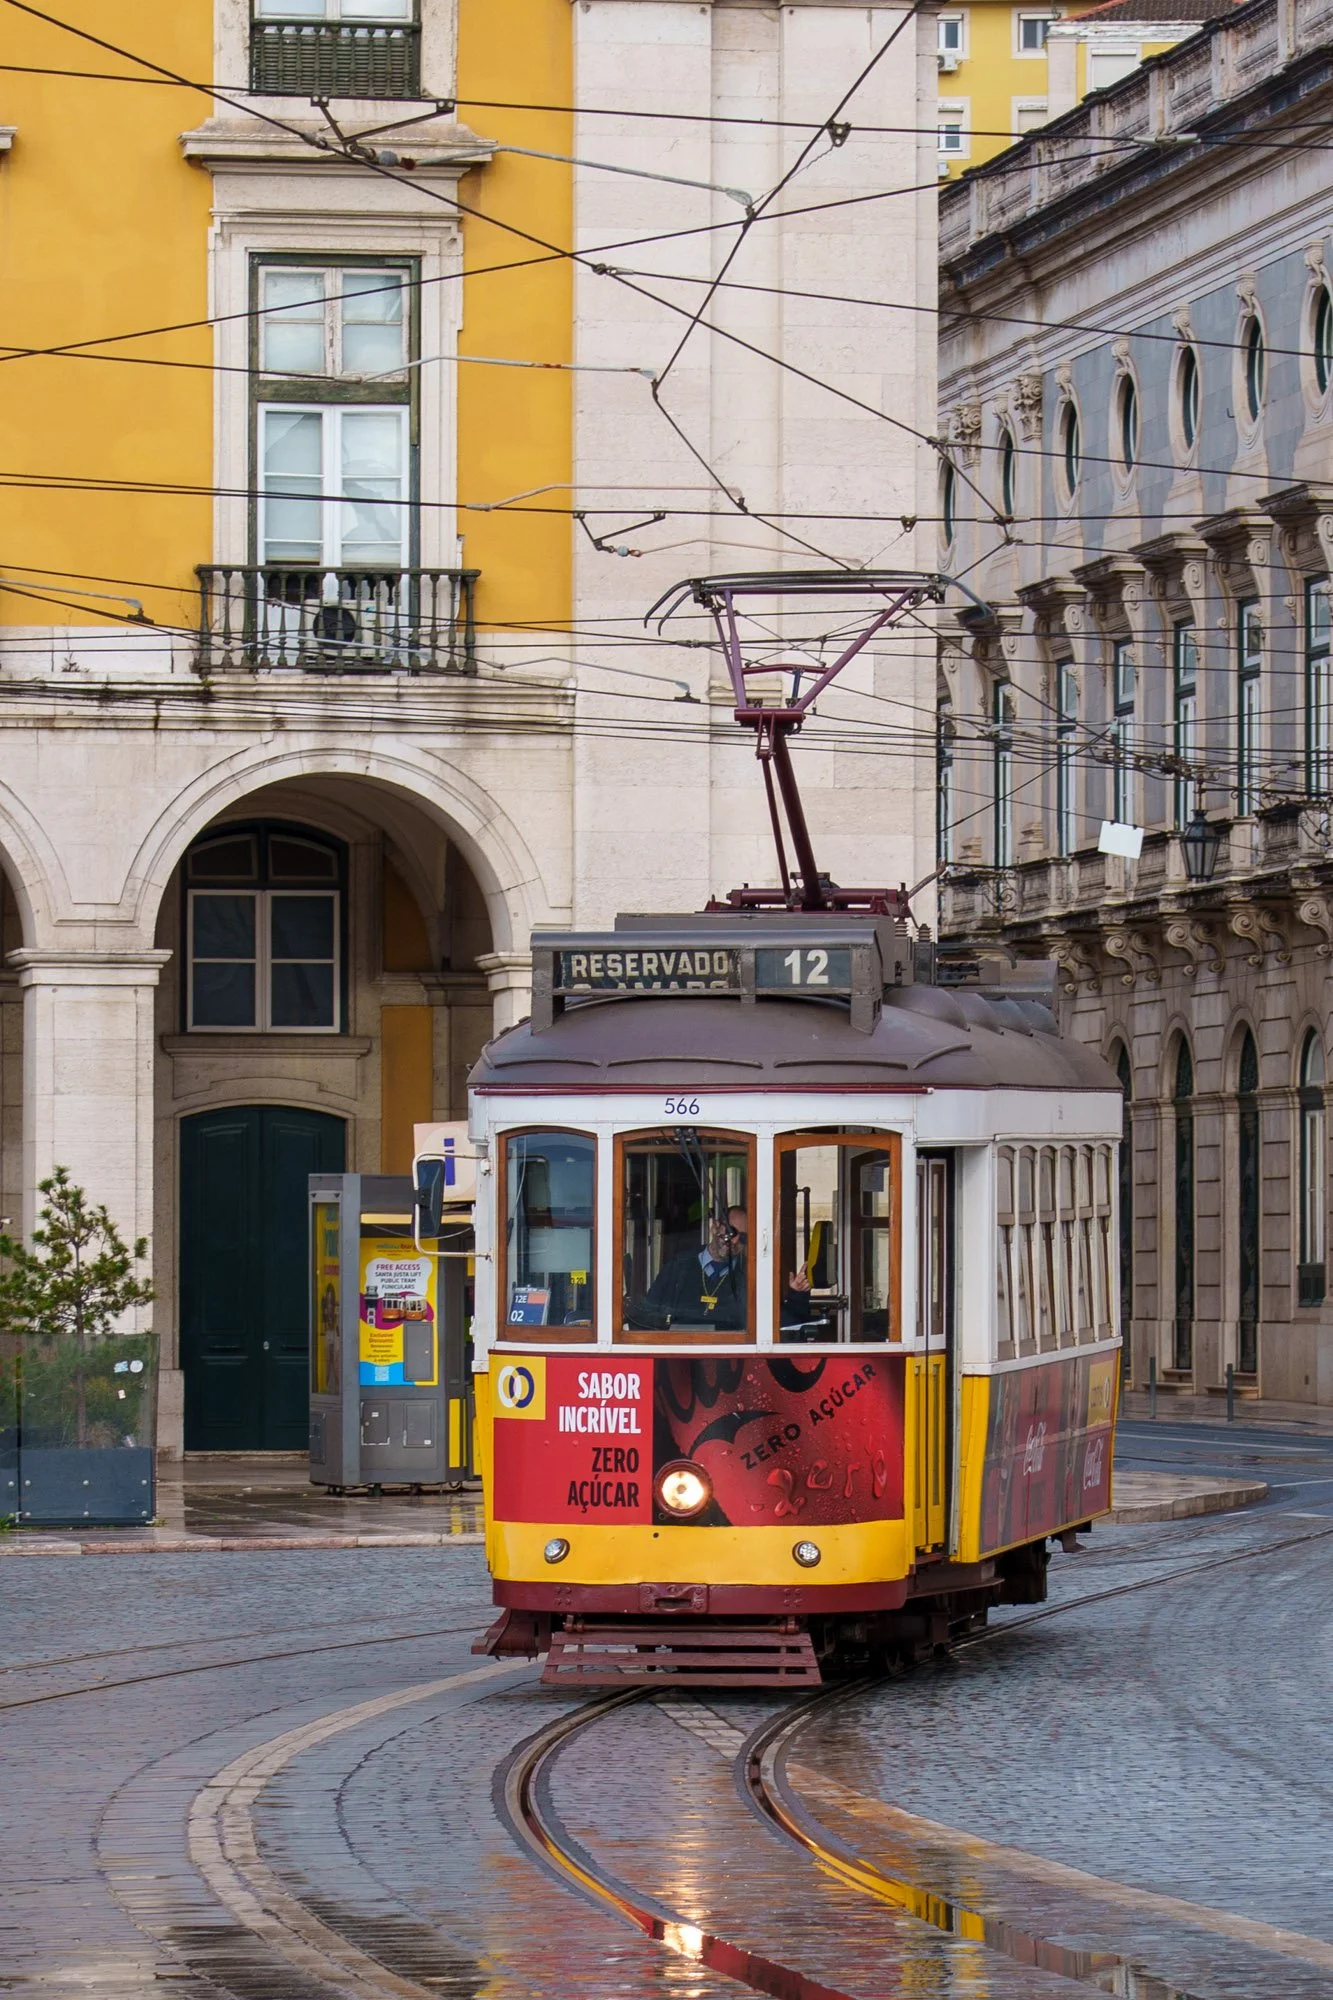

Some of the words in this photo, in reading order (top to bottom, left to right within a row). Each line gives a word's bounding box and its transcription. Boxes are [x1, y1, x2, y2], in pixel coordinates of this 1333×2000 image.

[571, 951, 729, 978] RESERVADO
[784, 949, 829, 985] 12
[664, 1098, 700, 1115] 566
[515, 1295, 527, 1304] 12E
[510, 1310, 524, 1322] 02
[578, 1372, 640, 1400] SABOR
[559, 1400, 641, 1434] INCRÍVEL
[740, 1423, 801, 1470] ZERO
[808, 1363, 877, 1426] AÇÚCAR
[591, 1447, 639, 1473] ZERO
[568, 1475, 639, 1513] AÇÚCAR
